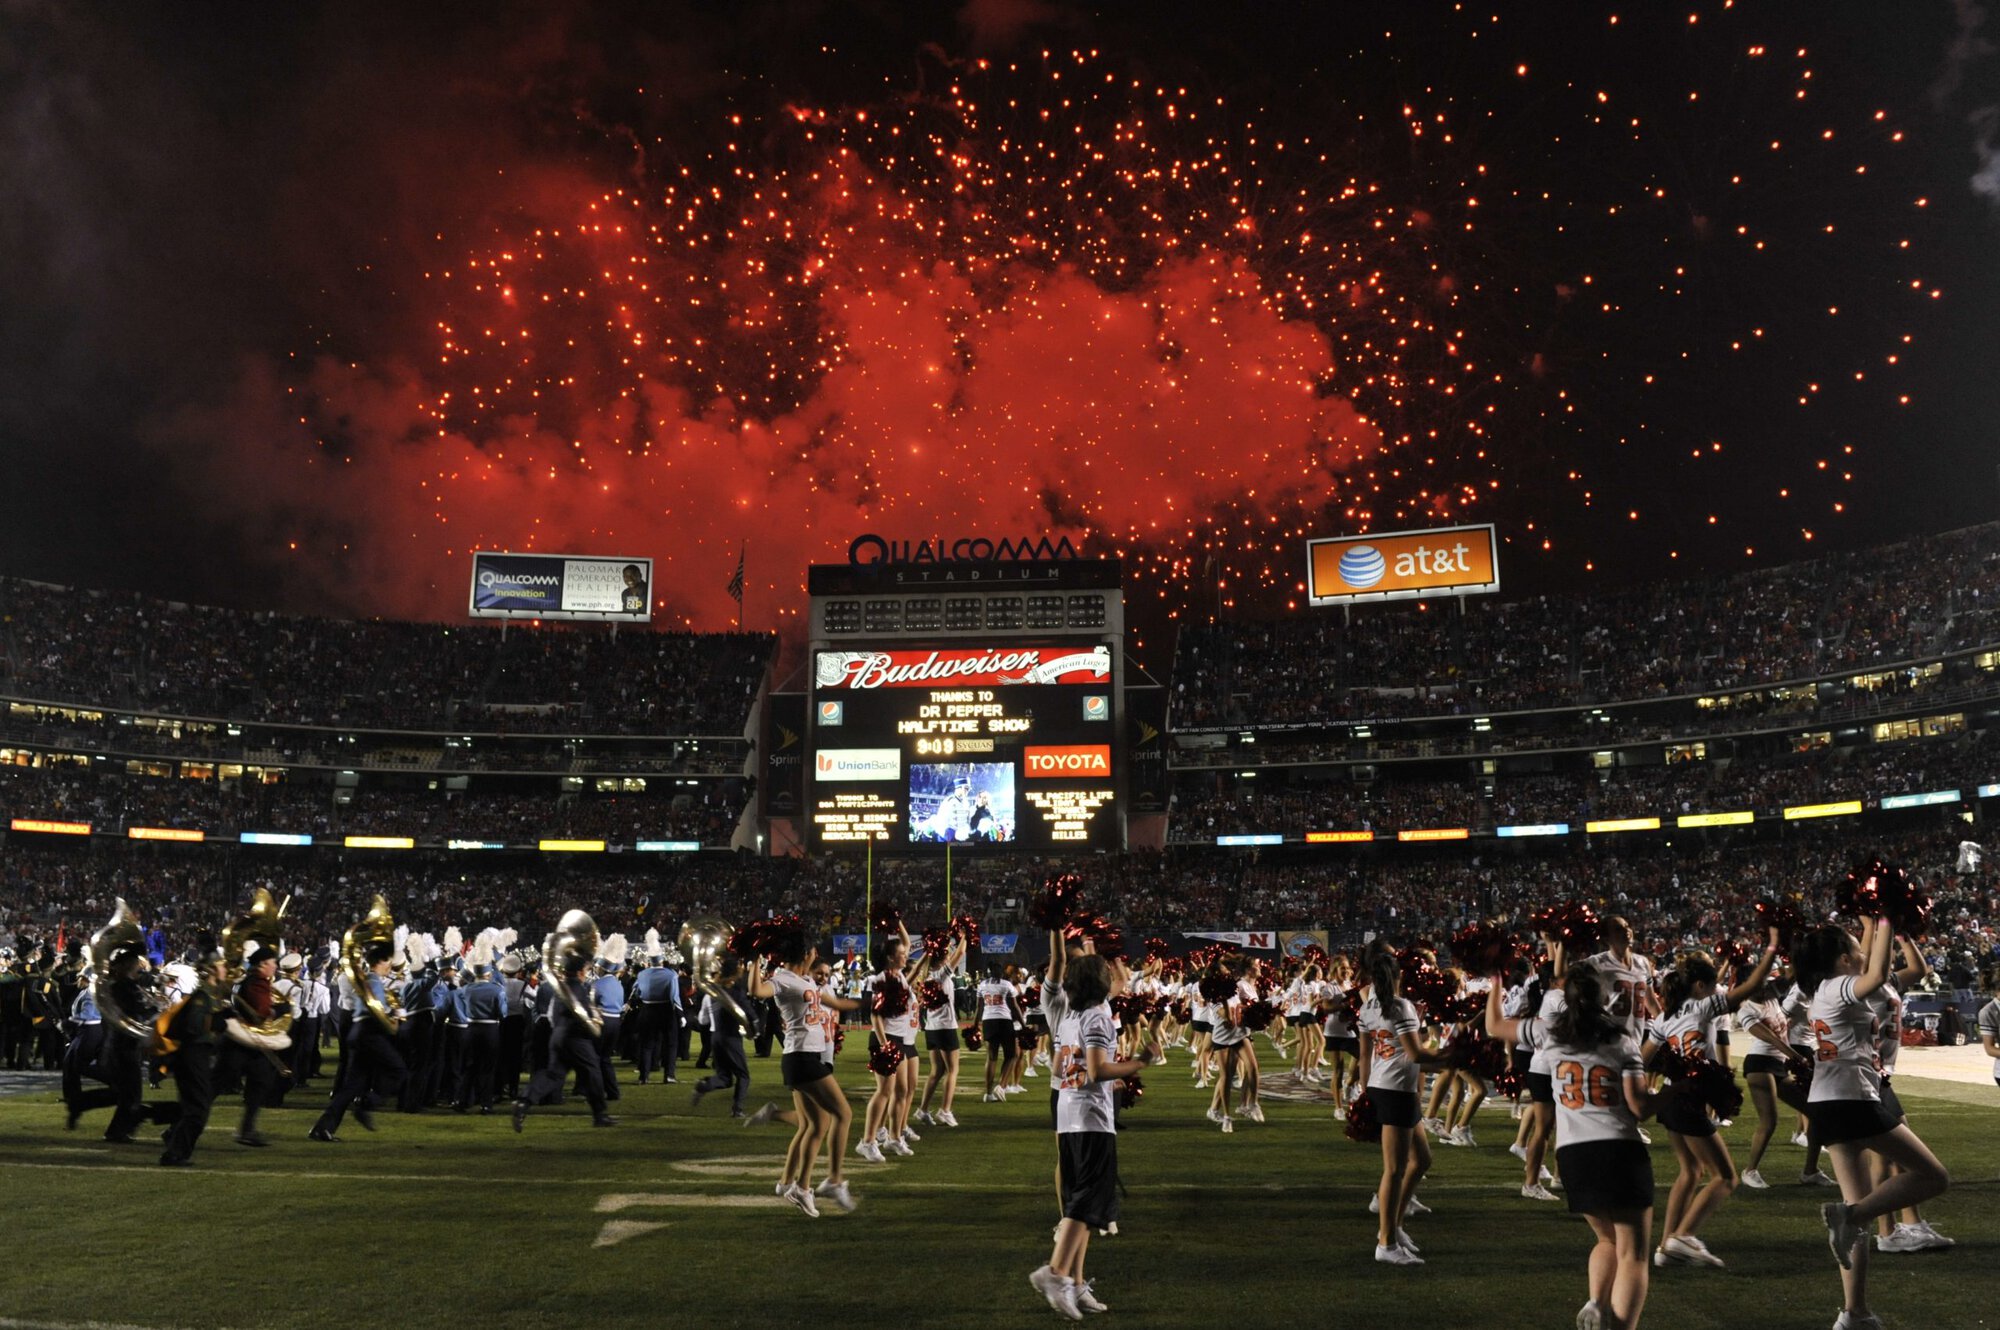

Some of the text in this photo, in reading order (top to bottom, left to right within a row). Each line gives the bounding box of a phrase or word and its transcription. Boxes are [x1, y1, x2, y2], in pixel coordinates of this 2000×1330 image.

[849, 533, 1081, 568] QUALCOMM
[1394, 542, 1471, 577] at&t
[567, 564, 622, 574] PALOMAR
[896, 568, 1060, 582] STADIUM
[479, 571, 560, 588] QUALCOMM
[567, 573, 621, 583] POMERADO
[495, 588, 546, 599] Innovation
[566, 584, 621, 592] HEALTH
[842, 648, 1041, 690] Budweiser
[1041, 660, 1081, 678] American
[1082, 657, 1107, 668] Lager
[930, 690, 994, 703] THANKS TO
[919, 704, 1003, 718] DR PEPPER
[897, 718, 1031, 734] HALFTIME SHOW
[837, 760, 898, 770] UnionBank
[1028, 753, 1107, 770] TOYOTA
[1307, 832, 1372, 841] WELLS FARGO
[1248, 933, 1268, 947] N
[1556, 1060, 1621, 1111] 36
